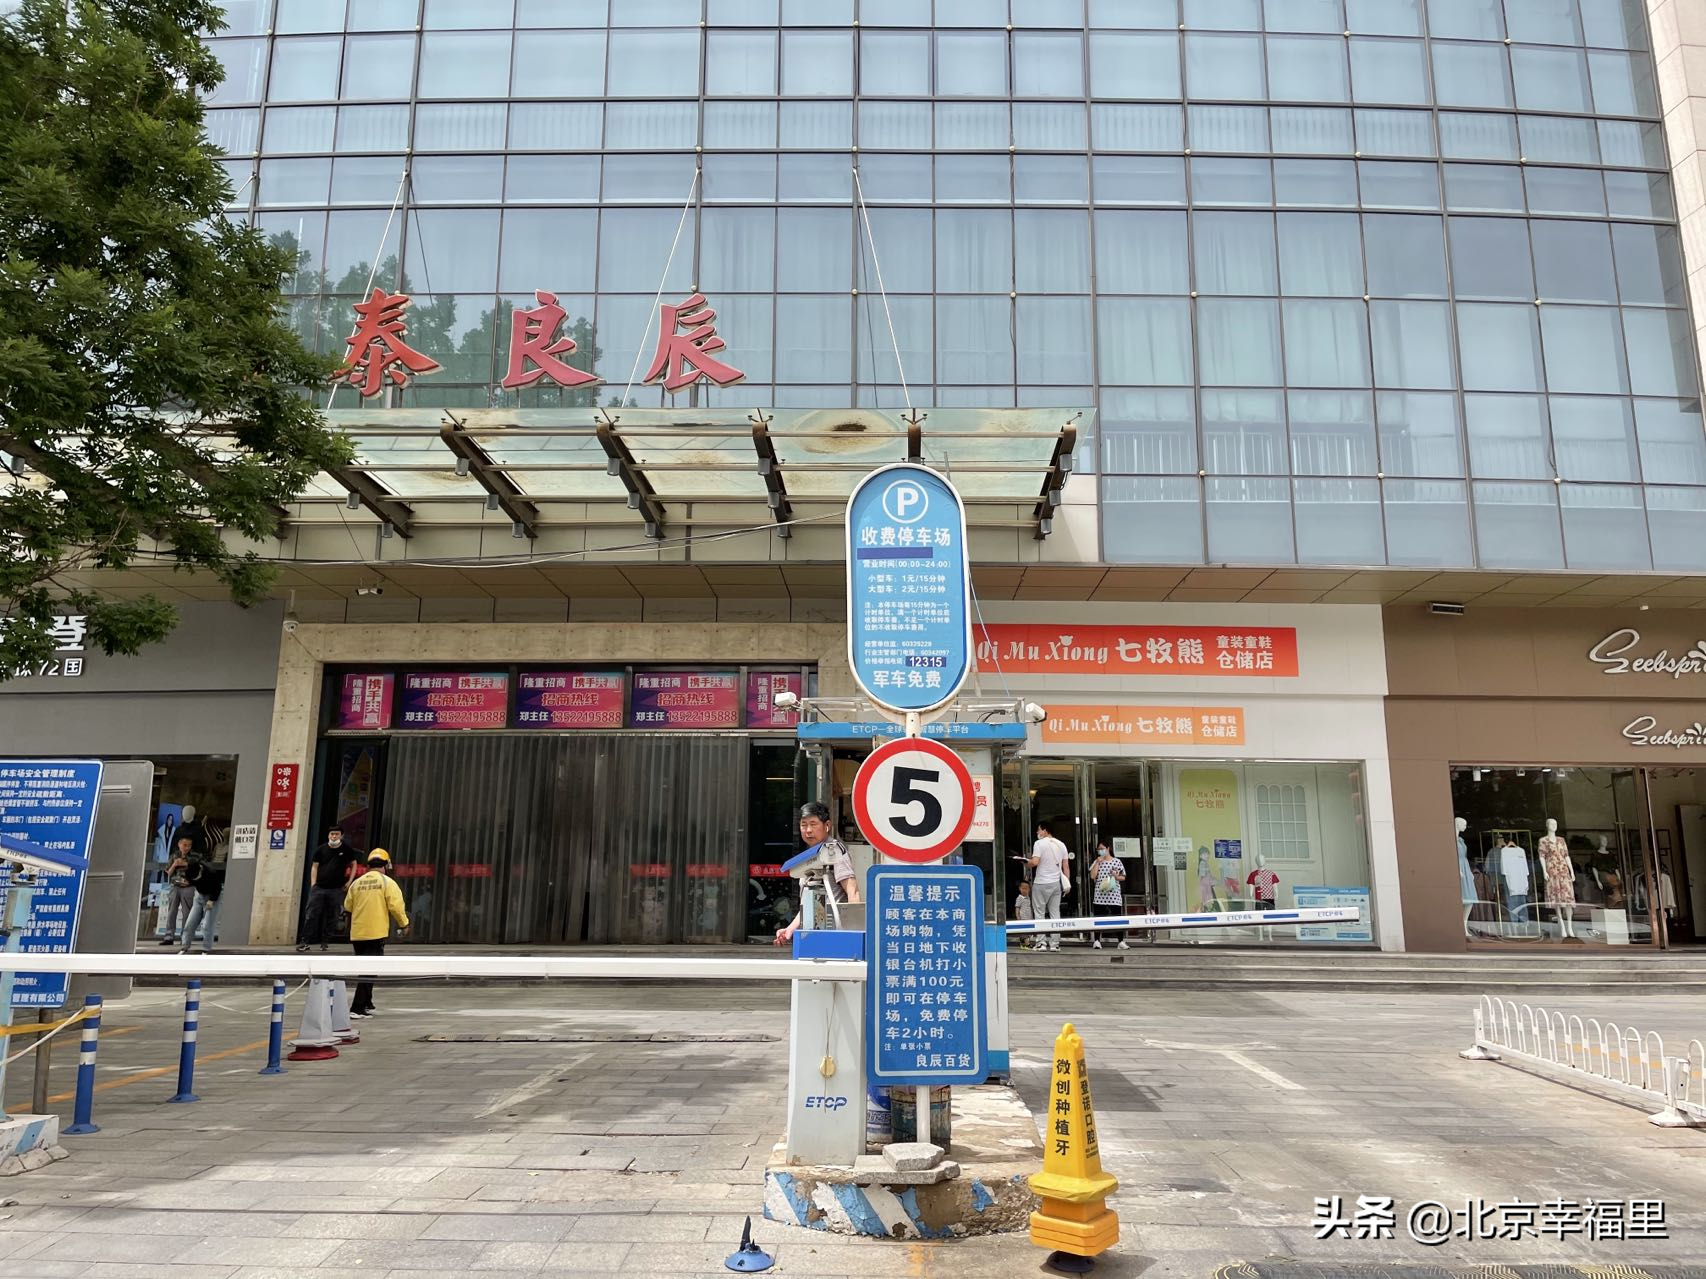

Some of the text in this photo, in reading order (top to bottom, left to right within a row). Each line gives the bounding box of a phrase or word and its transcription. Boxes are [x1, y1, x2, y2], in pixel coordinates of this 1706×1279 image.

[330, 287, 747, 399] 泰良辰
[897, 487, 919, 516] P
[861, 526, 951, 547] 收费停车场
[1215, 635, 1273, 649] 童装童鞋
[976, 636, 1205, 665] Qi Mu Xiong 七牧熊
[909, 656, 943, 667] 12315
[1215, 650, 1274, 670] 仓储店
[410, 677, 504, 689] 隆重招商 携手共赢
[524, 677, 618, 689] 隆重招商 携手共赢
[638, 676, 733, 689] 隆重招商 携手共赢
[872, 670, 942, 688] 军车免费
[351, 678, 363, 713] 隆重招商
[364, 677, 383, 725] 携手共赢
[427, 692, 485, 707] 招商热线
[541, 692, 599, 707] 招商热线
[657, 692, 714, 706] 招商热线
[757, 677, 768, 711] 隆重招商
[772, 677, 788, 724] 携赢
[405, 711, 434, 722] 郑主任
[519, 711, 549, 721] 郑主任
[635, 711, 665, 722] 郑主任
[1065, 717, 1089, 732] Mu
[1136, 716, 1193, 735] 七牧熊
[1200, 724, 1238, 737] 仓储店
[888, 766, 943, 838] 5
[889, 885, 961, 902] 温馨提示
[886, 907, 966, 921] 顾客在本商
[886, 924, 966, 937] 场购物，凭
[886, 941, 967, 954] 当日地下收
[886, 958, 967, 971] 银台机打小
[886, 975, 964, 988] 票满100元
[886, 992, 968, 1005] 即可在停车
[886, 1009, 968, 1022] 场，免费停
[886, 1026, 955, 1040] 车2小时。
[916, 1054, 971, 1068] 良辰百货
[805, 1096, 848, 1111] ETCP
[1055, 1059, 1071, 1156] 微创种植牙
